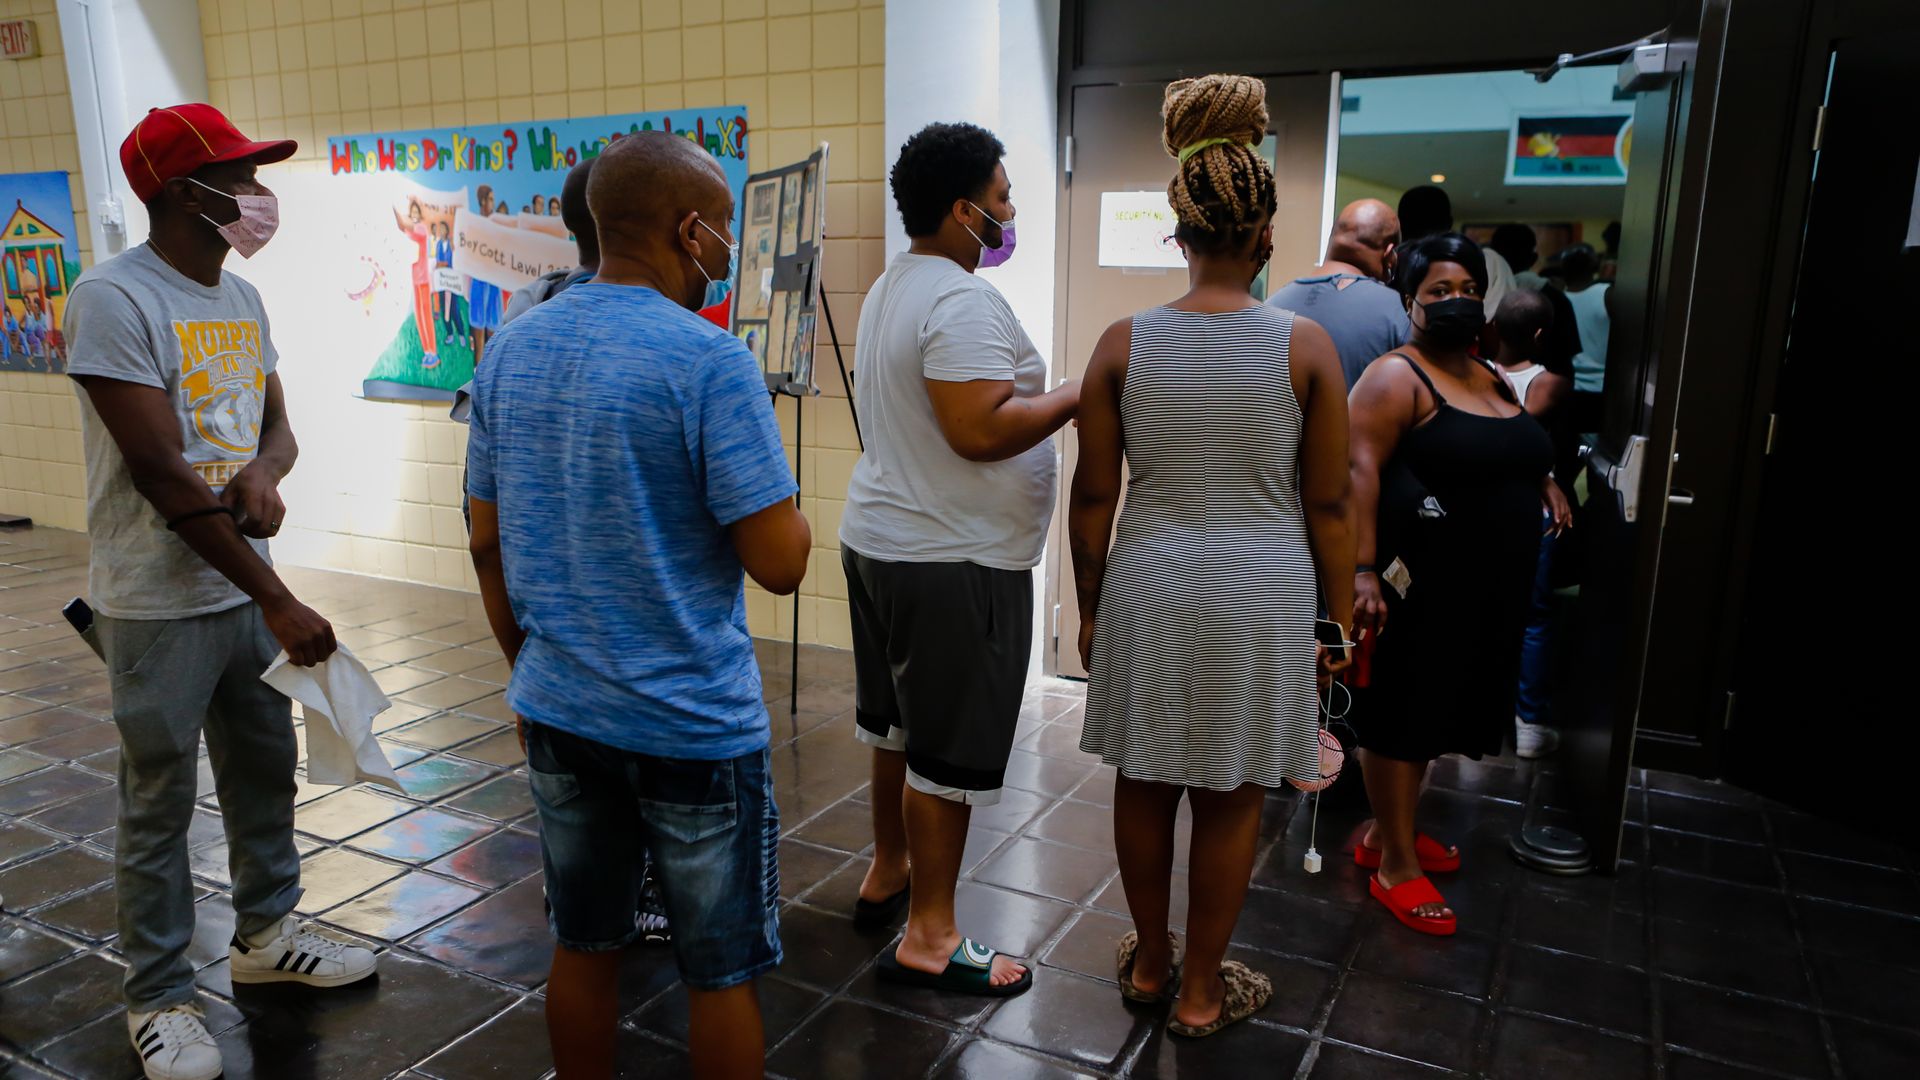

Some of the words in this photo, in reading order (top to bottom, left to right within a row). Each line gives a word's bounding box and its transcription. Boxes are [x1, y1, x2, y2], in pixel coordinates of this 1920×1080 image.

[0, 22, 26, 55] EXIT
[331, 140, 377, 175] Who
[377, 138, 419, 171] Was
[421, 138, 451, 171] Dr
[452, 129, 518, 172] King?
[527, 126, 577, 171] Who
[511, 253, 541, 278] Level
